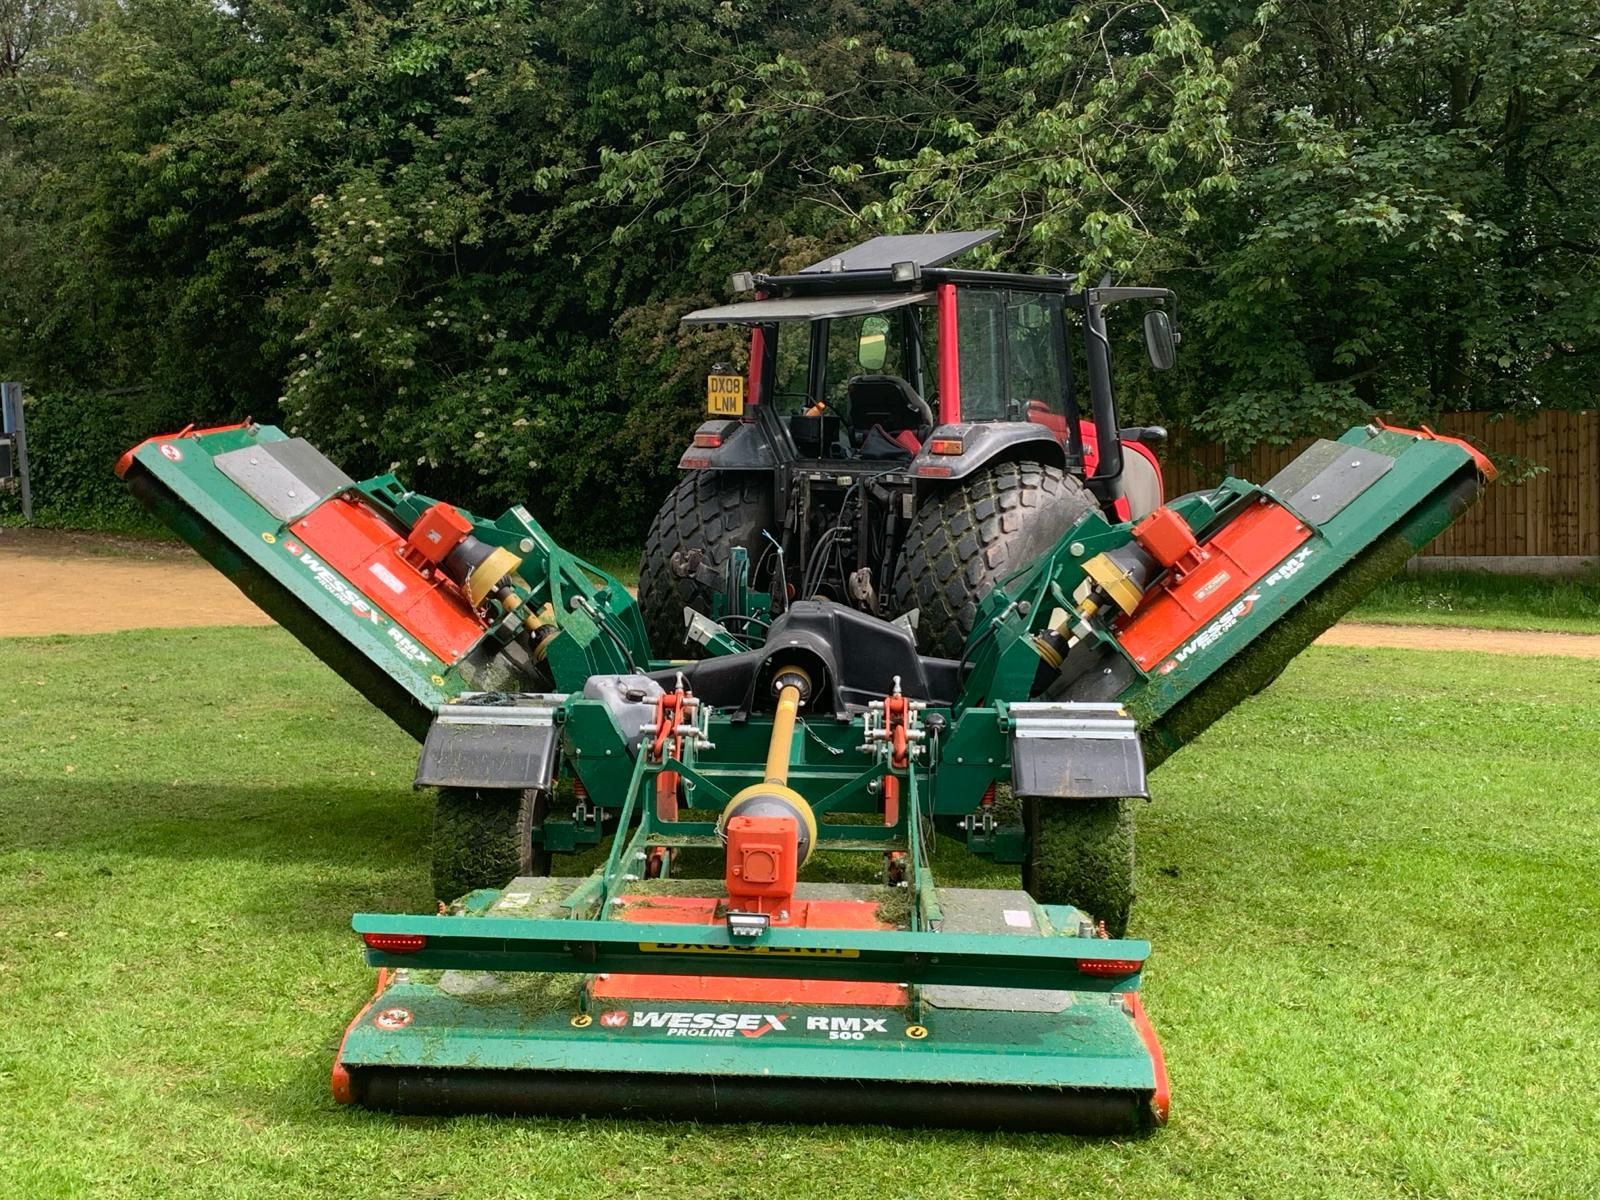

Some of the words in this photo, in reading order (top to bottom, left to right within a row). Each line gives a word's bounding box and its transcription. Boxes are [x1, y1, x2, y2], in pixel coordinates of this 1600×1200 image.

[711, 377, 741, 394] DX08
[299, 553, 384, 625] WESSEX
[387, 627, 432, 666] RMX
[1175, 590, 1261, 662] WESSEX
[1265, 547, 1313, 586] RMX
[632, 1011, 788, 1037] WESSEX
[806, 1016, 888, 1033] RMX
[666, 1028, 735, 1038] PROLINE
[829, 1031, 865, 1041] 500
